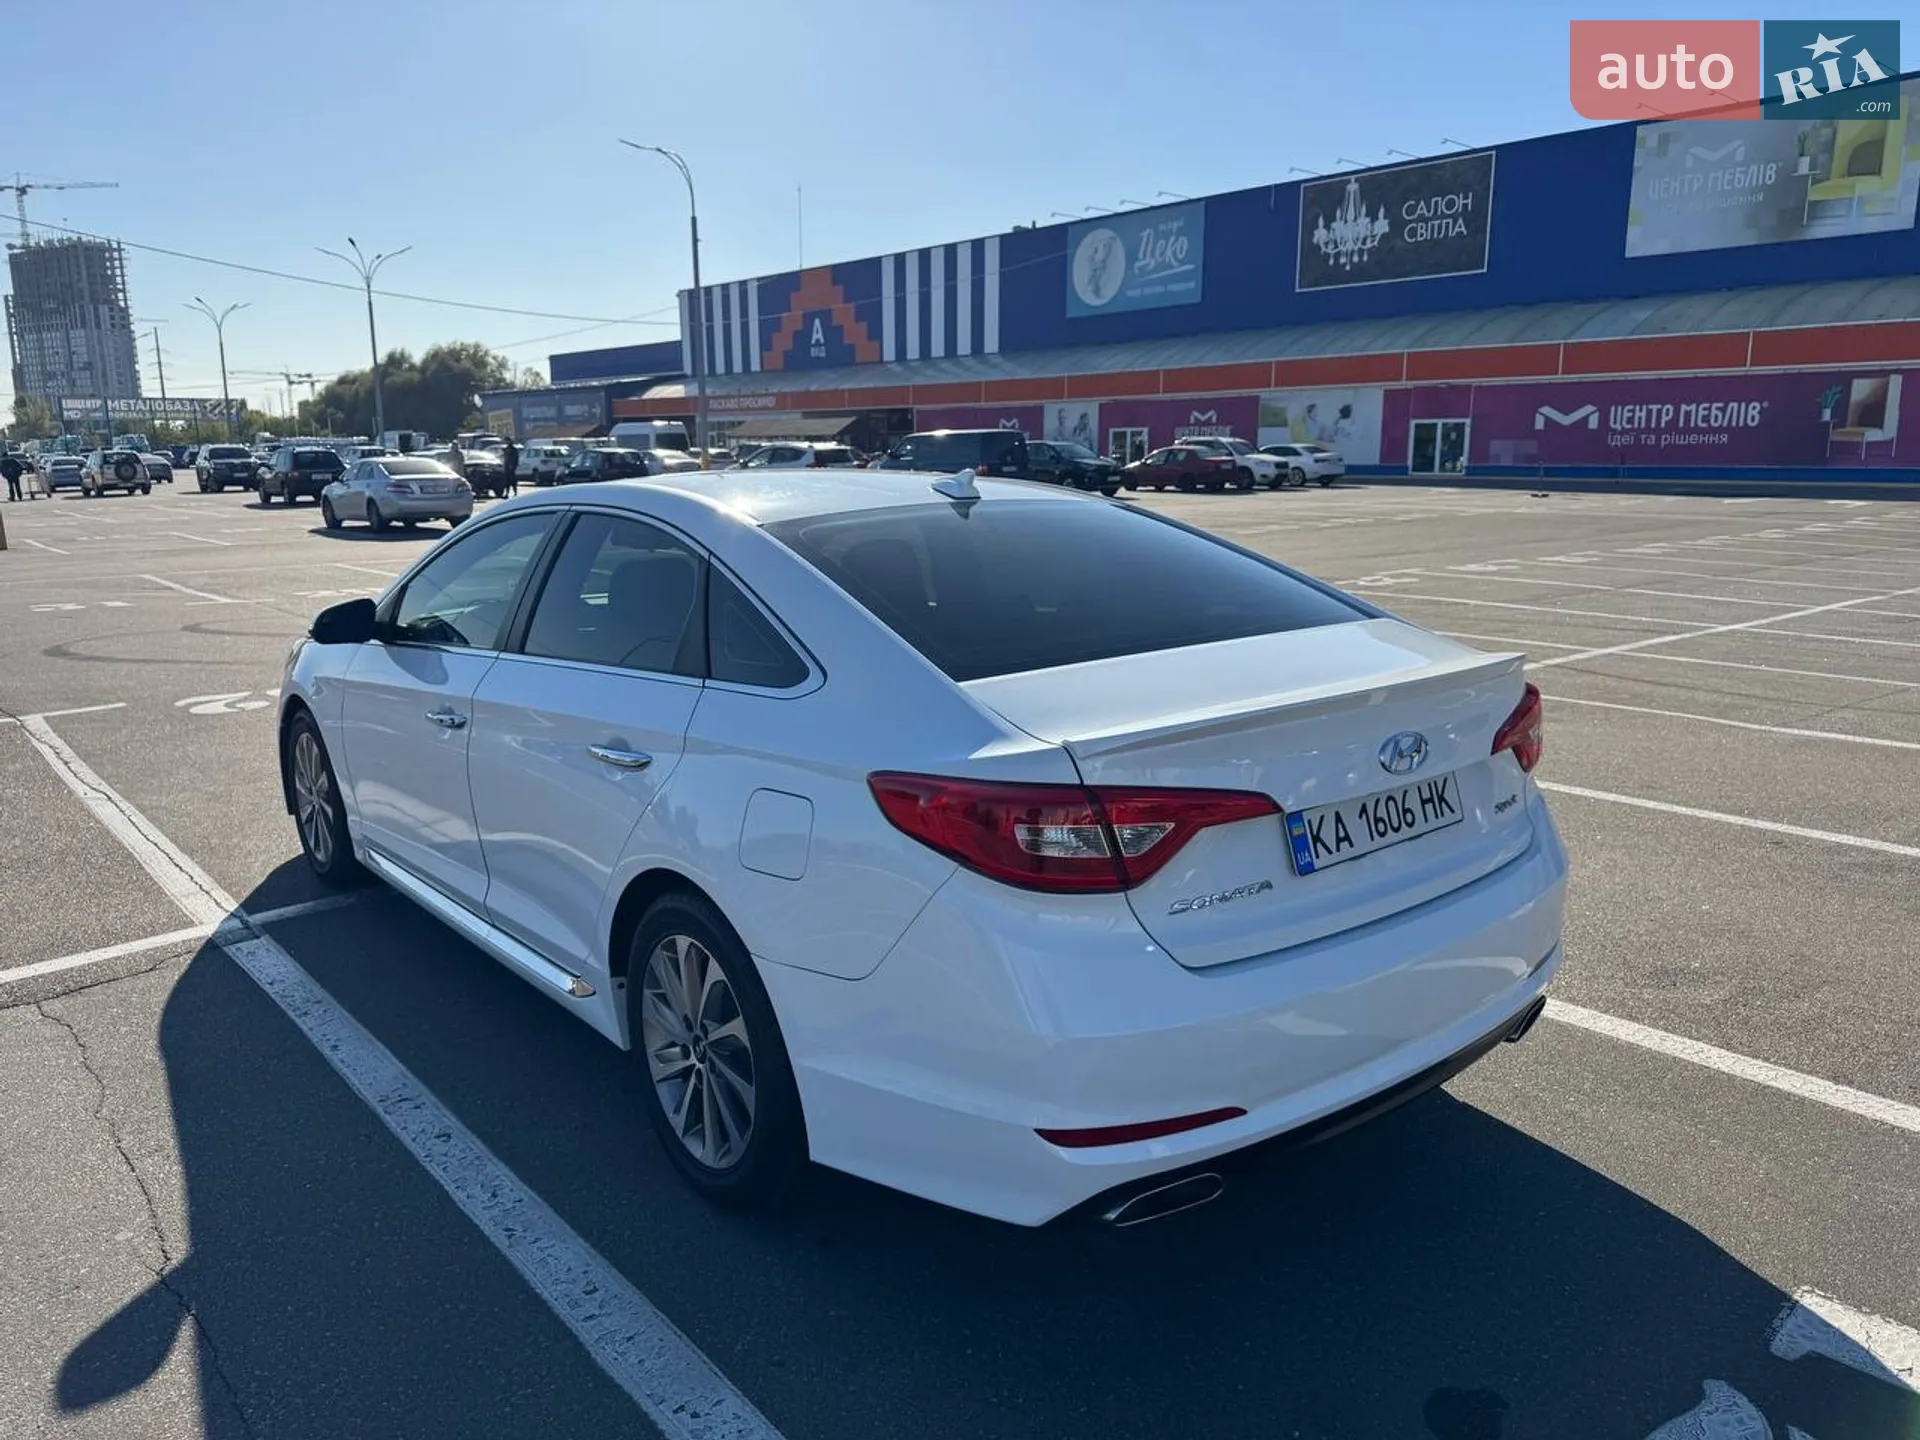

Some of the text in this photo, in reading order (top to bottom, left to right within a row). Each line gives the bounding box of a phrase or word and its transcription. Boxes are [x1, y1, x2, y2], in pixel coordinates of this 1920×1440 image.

[1648, 162, 1777, 200] ЦЕНТР МЕБЛІВ
[1402, 192, 1473, 220] САЛОН
[1404, 217, 1467, 243] СВІТЛА
[1133, 228, 1189, 275] Деко
[1609, 401, 1761, 431] ЦЕНТР МЕБЛІВ
[1608, 431, 1728, 448] ідеї та рішення
[1307, 810, 1355, 859] KA
[1358, 789, 1416, 842] 1606
[1417, 776, 1456, 824] HK
[1297, 850, 1313, 866] UA
[1167, 880, 1273, 915] SONATA
